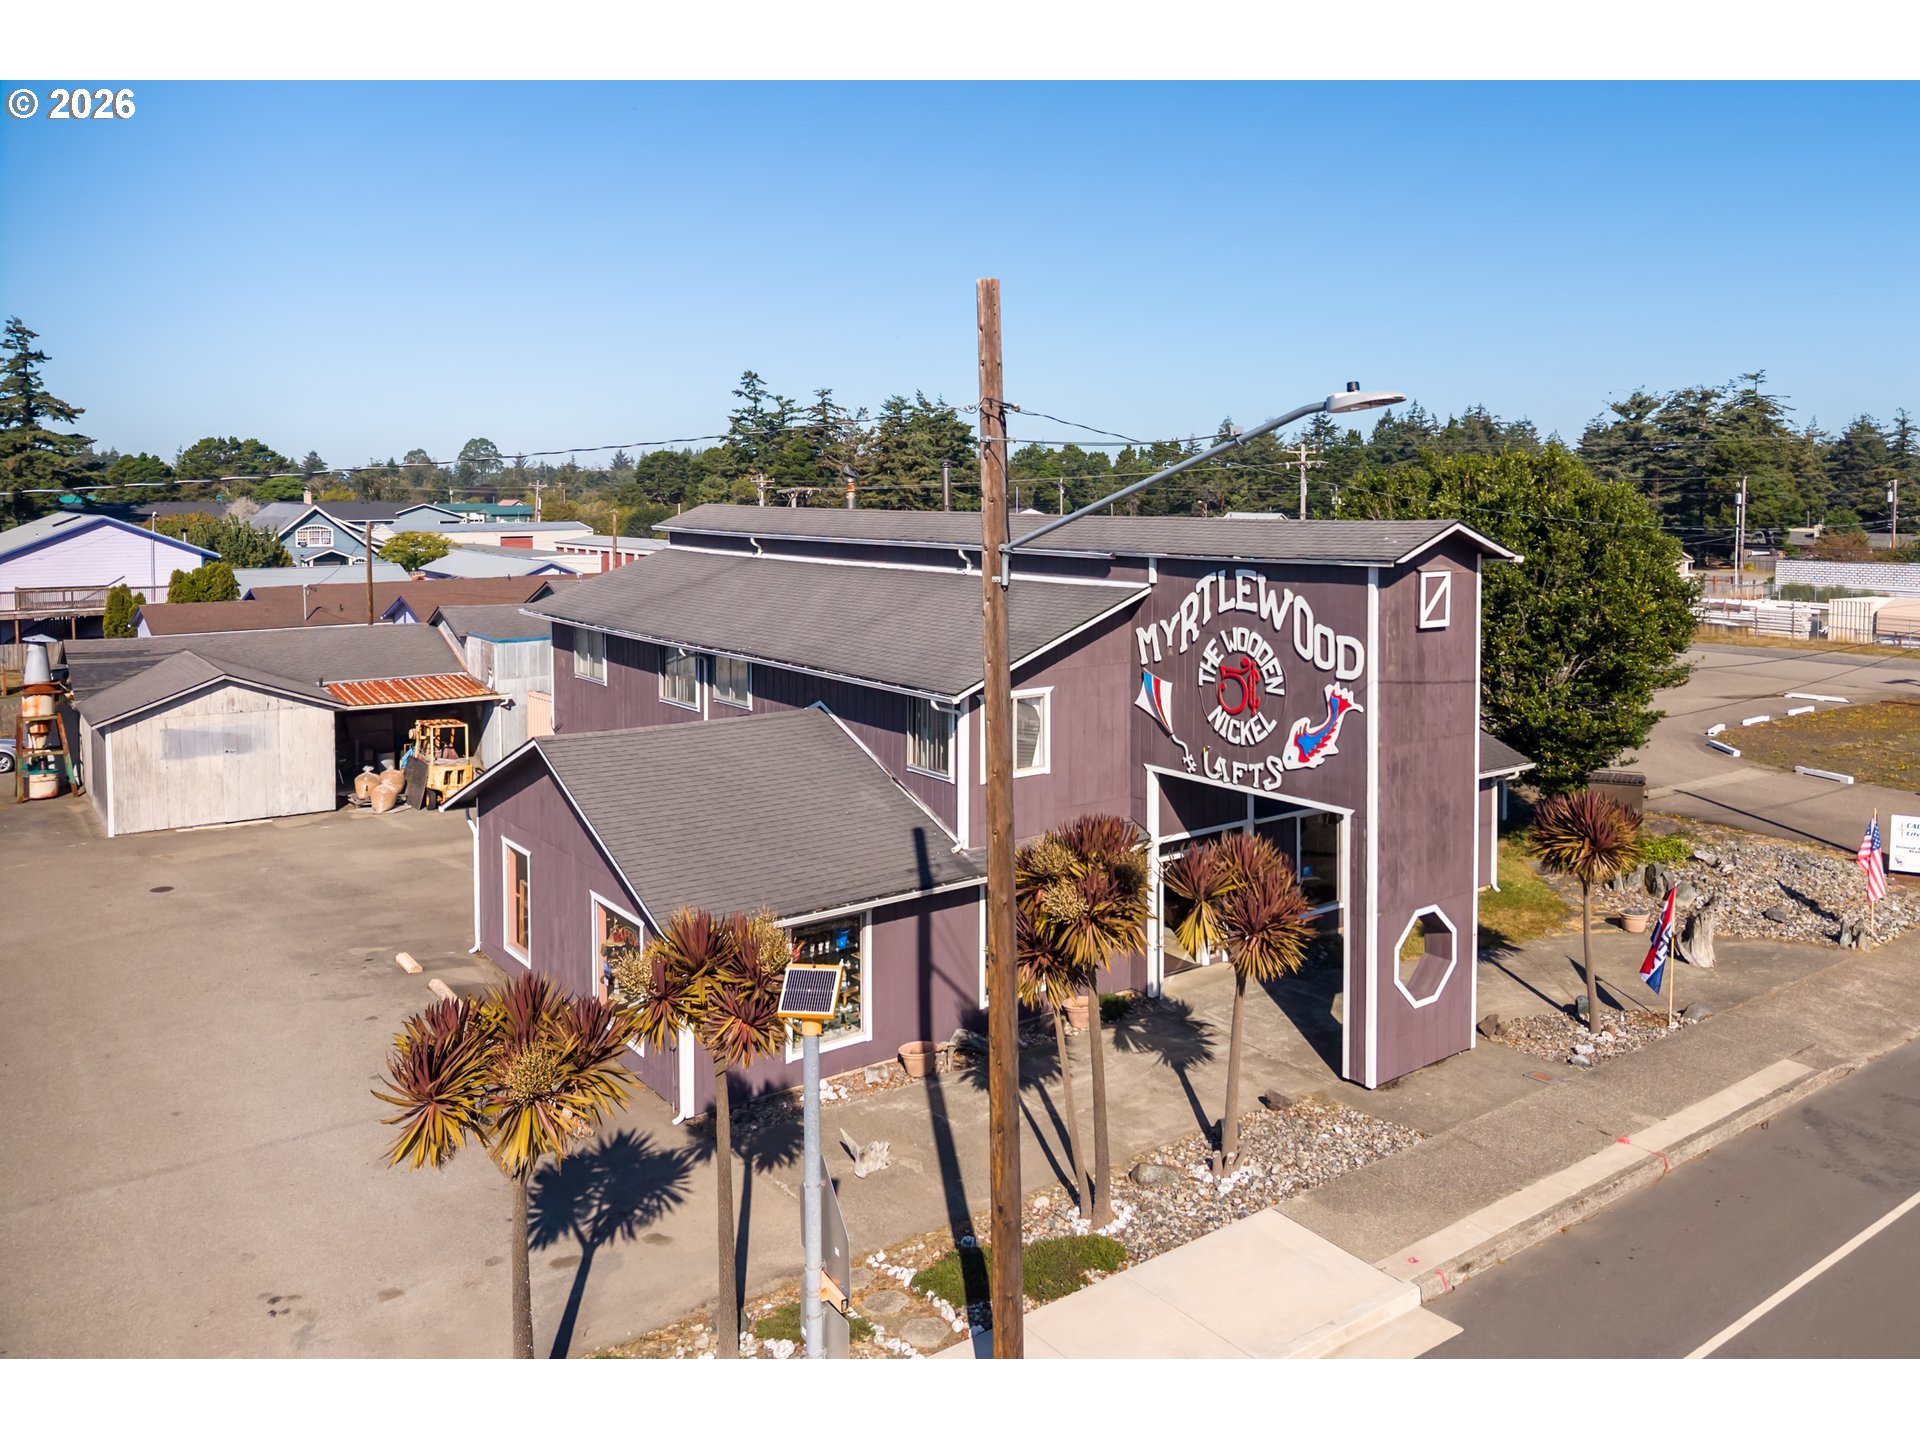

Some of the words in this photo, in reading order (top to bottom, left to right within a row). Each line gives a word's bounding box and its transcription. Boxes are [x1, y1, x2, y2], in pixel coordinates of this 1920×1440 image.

[1136, 569, 1365, 680] MYRTLEWOOD
[1198, 636, 1224, 687] THE
[1220, 626, 1286, 696] WOODEN
[1207, 704, 1278, 746] NICKEL
